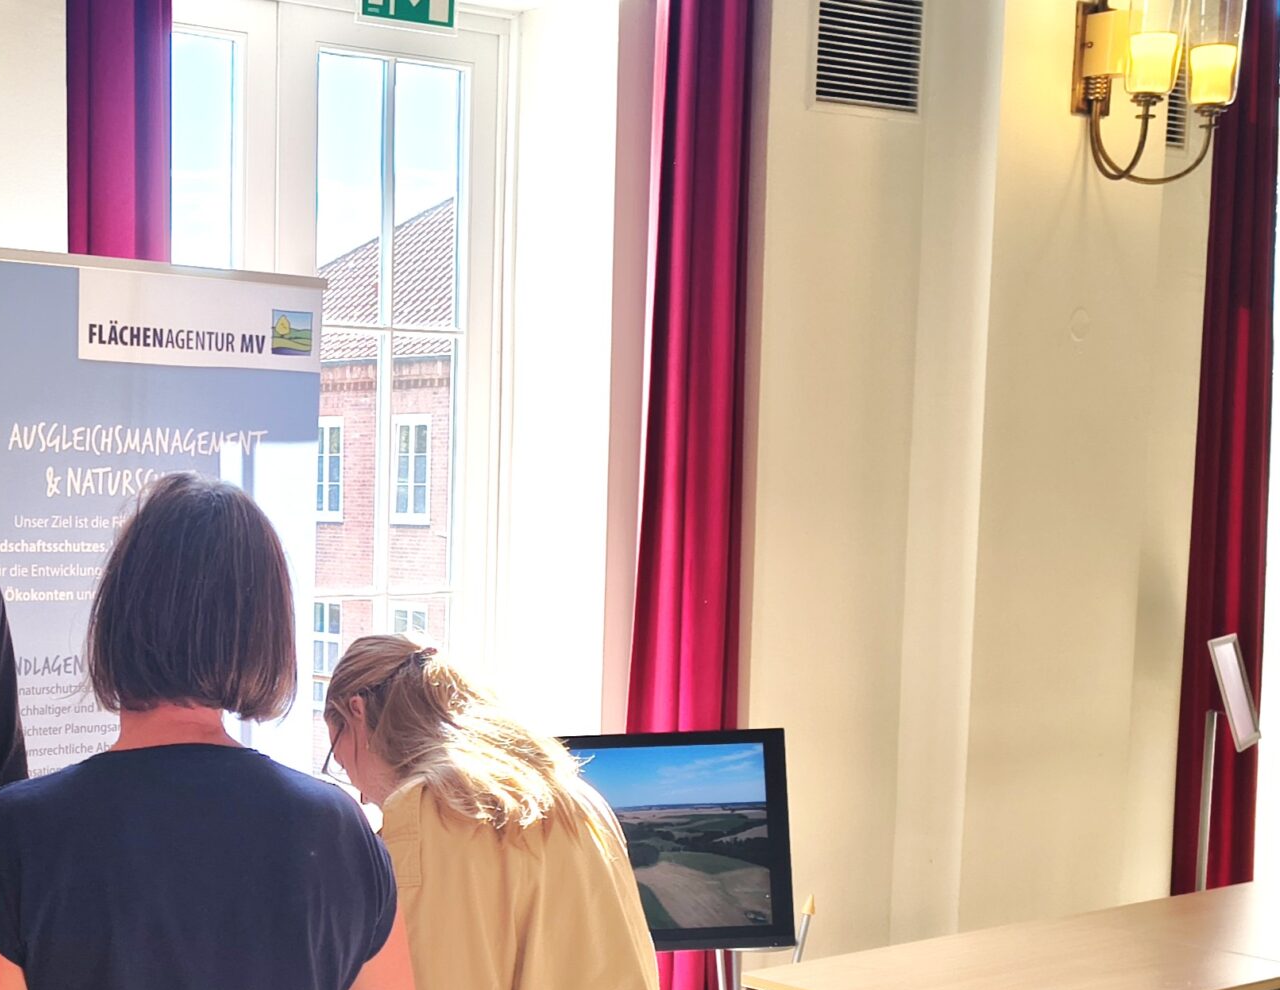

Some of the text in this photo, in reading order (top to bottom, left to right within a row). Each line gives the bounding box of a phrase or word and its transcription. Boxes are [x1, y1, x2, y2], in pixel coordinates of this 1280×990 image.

[89, 320, 266, 354] FLÄCHENAGENTUR MV
[8, 422, 269, 456] AUSGLEICHSMANAGEMENT
[46, 466, 61, 498] &
[14, 515, 48, 529] Unser
[51, 515, 72, 529] Ziel
[75, 516, 88, 529] ist
[91, 515, 109, 529] die
[9, 564, 28, 577] die
[31, 564, 102, 580] Entwicklung
[4, 586, 73, 601] Ökokonten
[74, 702, 95, 714] und
